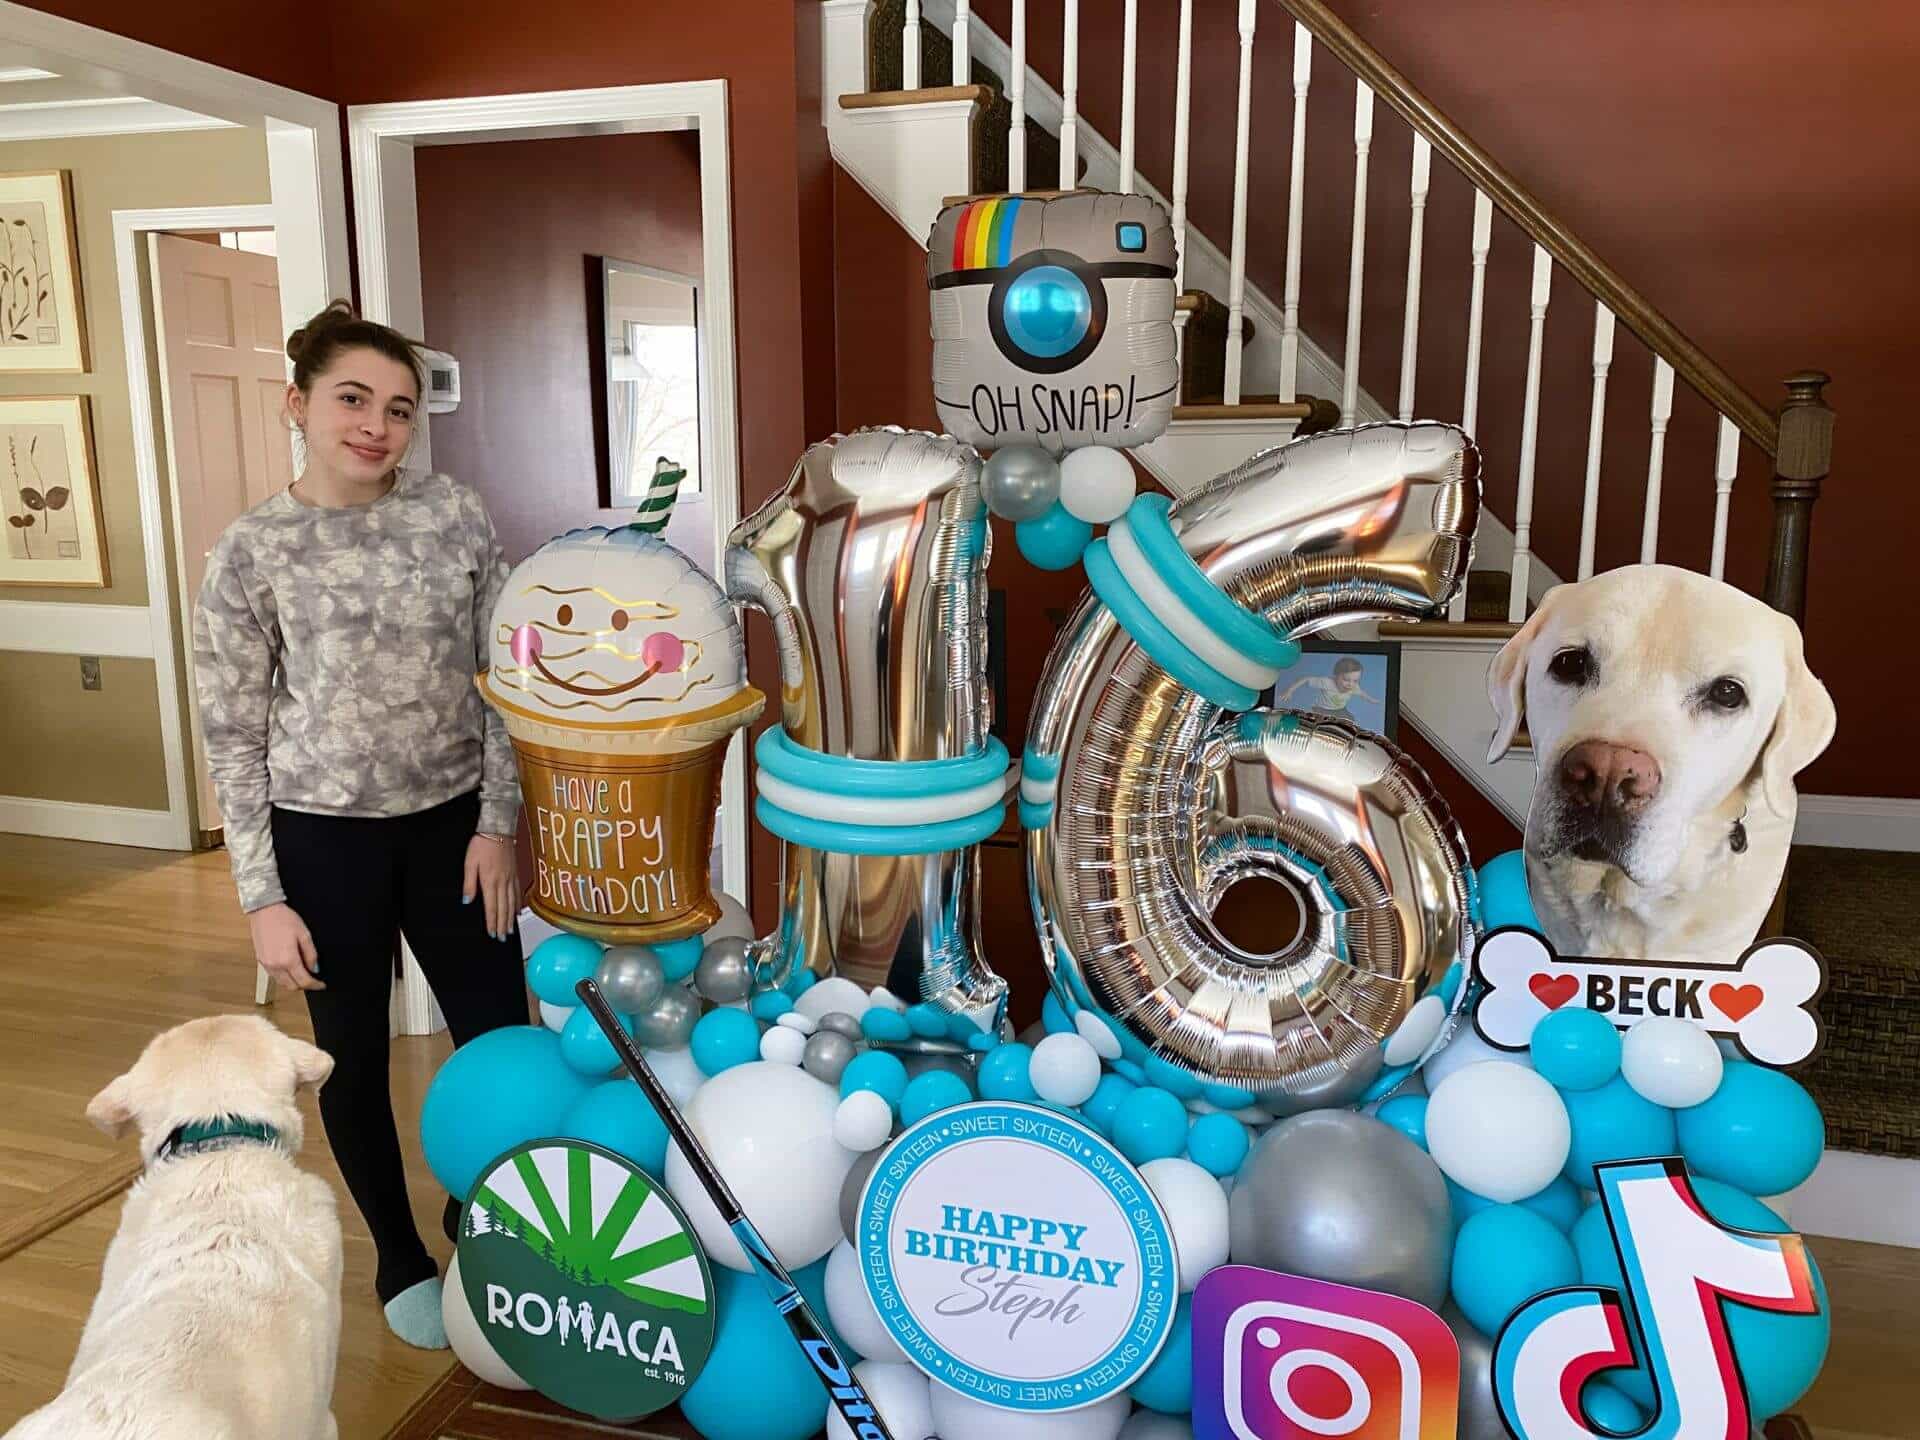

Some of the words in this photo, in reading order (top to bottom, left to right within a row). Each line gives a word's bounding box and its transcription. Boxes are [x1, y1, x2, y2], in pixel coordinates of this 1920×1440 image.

[971, 383, 1025, 436] OH
[1032, 374, 1136, 434] SNAP!
[618, 779, 632, 814] a
[1586, 973, 1704, 1019] BECK
[950, 1115, 1009, 1136] SWEET
[1012, 1117, 1083, 1154] SIXTEEN
[869, 1177, 896, 1232] SWEET
[888, 1131, 943, 1180] SIXTEEN
[941, 1204, 1088, 1251] HAPPY
[1091, 1154, 1142, 1206] SWEET
[1133, 1208, 1164, 1278] SIXTEEN
[867, 1245, 898, 1310] SIXTEEN
[904, 1229, 1125, 1288] BIRTHDAY
[934, 1263, 1088, 1341] Steph
[1133, 1290, 1164, 1346] SWEET
[486, 1283, 684, 1371] ROMACA
[891, 1313, 937, 1361] SWEET
[644, 1367, 660, 1379] est.
[664, 1370, 686, 1386] 1916
[945, 1362, 1012, 1399] SIXTEEN
[1083, 1343, 1140, 1391] SIXTEEN
[1015, 1383, 1074, 1401] SWEET
